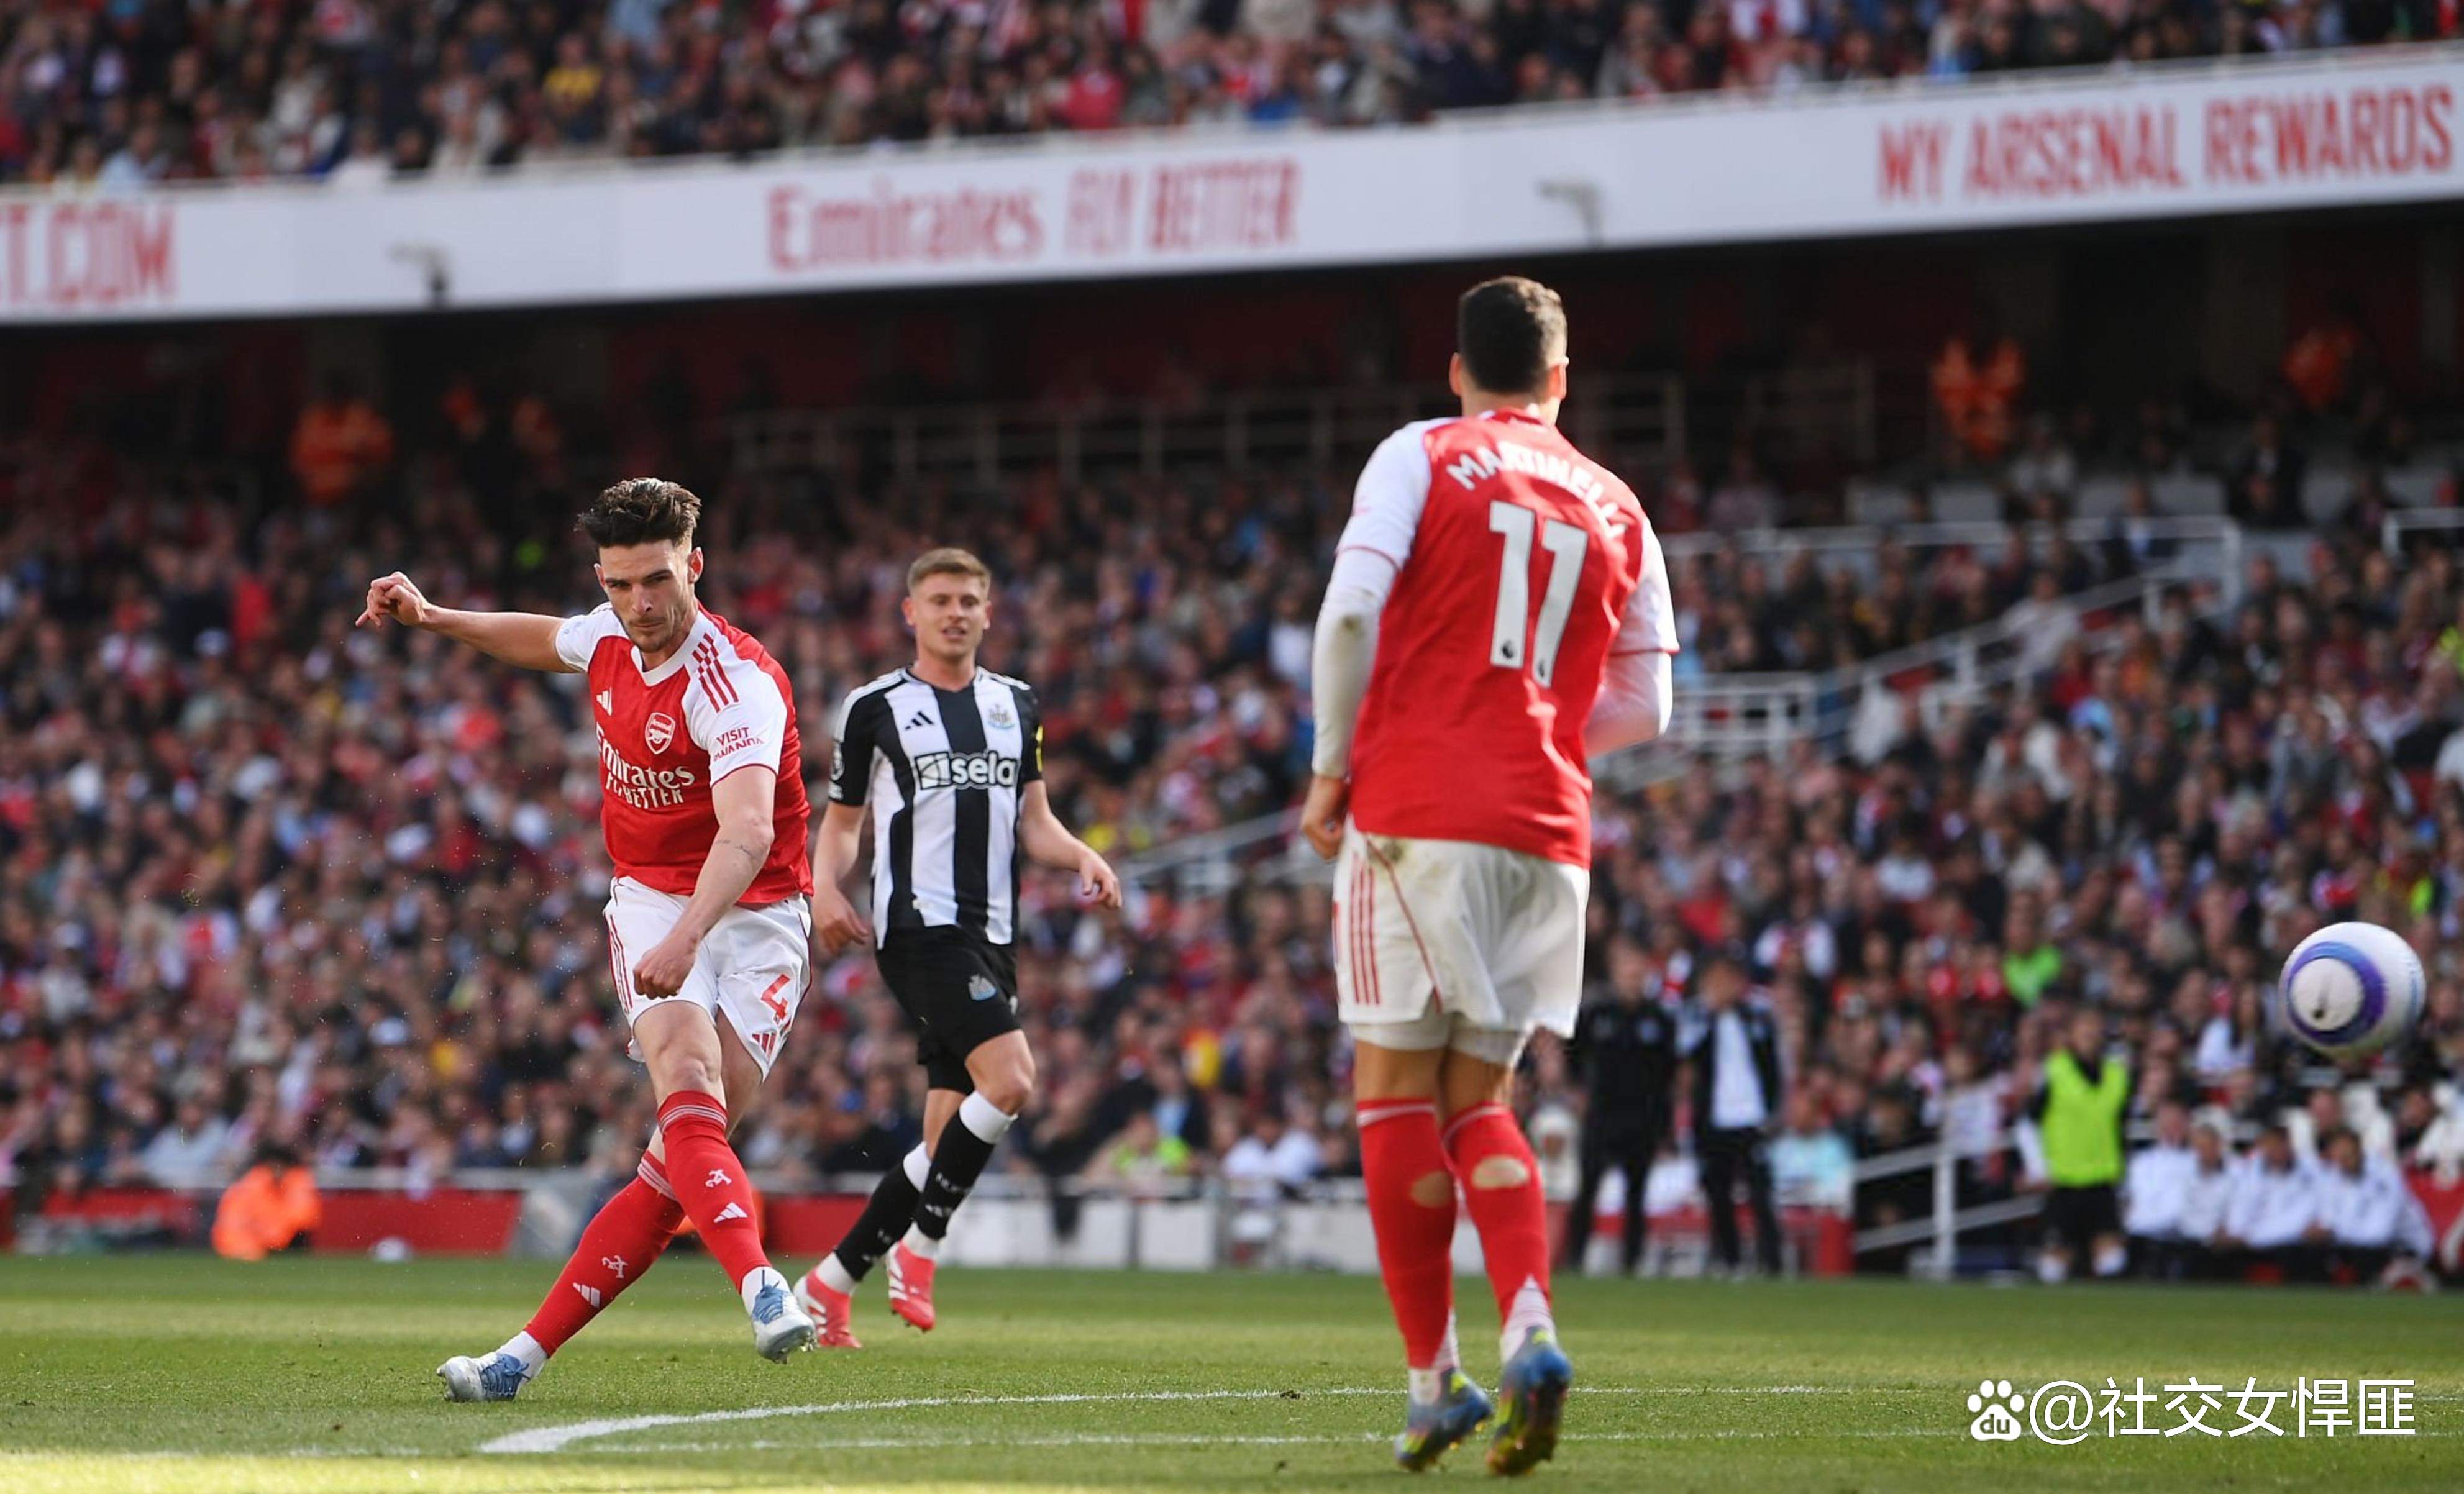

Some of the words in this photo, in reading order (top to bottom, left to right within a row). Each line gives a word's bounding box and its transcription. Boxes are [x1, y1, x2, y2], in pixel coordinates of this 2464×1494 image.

[1874, 119, 1951, 204] MY
[1962, 103, 2187, 198] ARSENAL
[2202, 84, 2453, 185] REWARDS
[0, 201, 179, 306] T.COM
[767, 175, 1045, 273] Emirates
[1148, 157, 1302, 251] BETTER
[1489, 499, 1589, 688] 11
[596, 721, 695, 789] Emirates
[716, 727, 749, 746] VISIT
[951, 750, 1017, 786] sela
[760, 973, 790, 1024] 4
